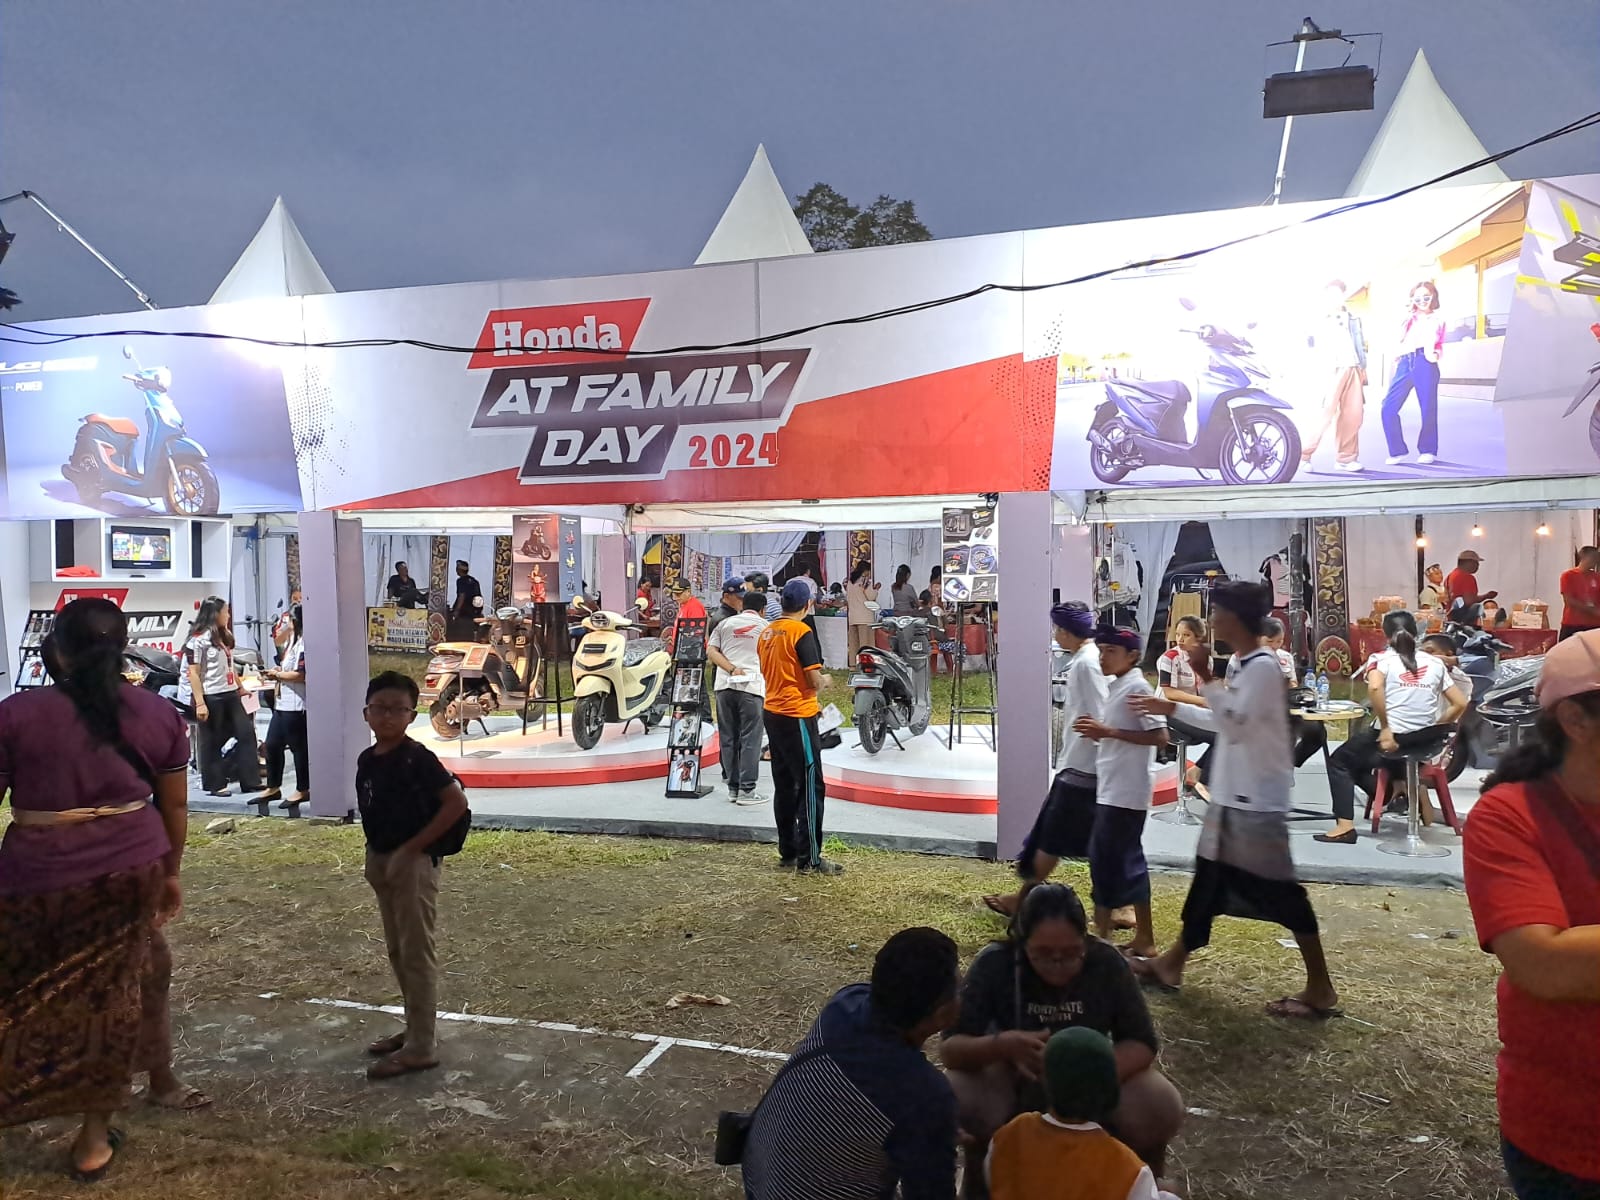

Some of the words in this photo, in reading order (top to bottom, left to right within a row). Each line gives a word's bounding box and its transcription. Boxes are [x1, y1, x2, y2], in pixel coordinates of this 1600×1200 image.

[491, 315, 622, 357] Honda
[486, 375, 569, 417] AT
[571, 362, 791, 413] FAMILY
[539, 424, 665, 467] DAY
[688, 432, 779, 467] 2024
[127, 615, 177, 633] MILY
